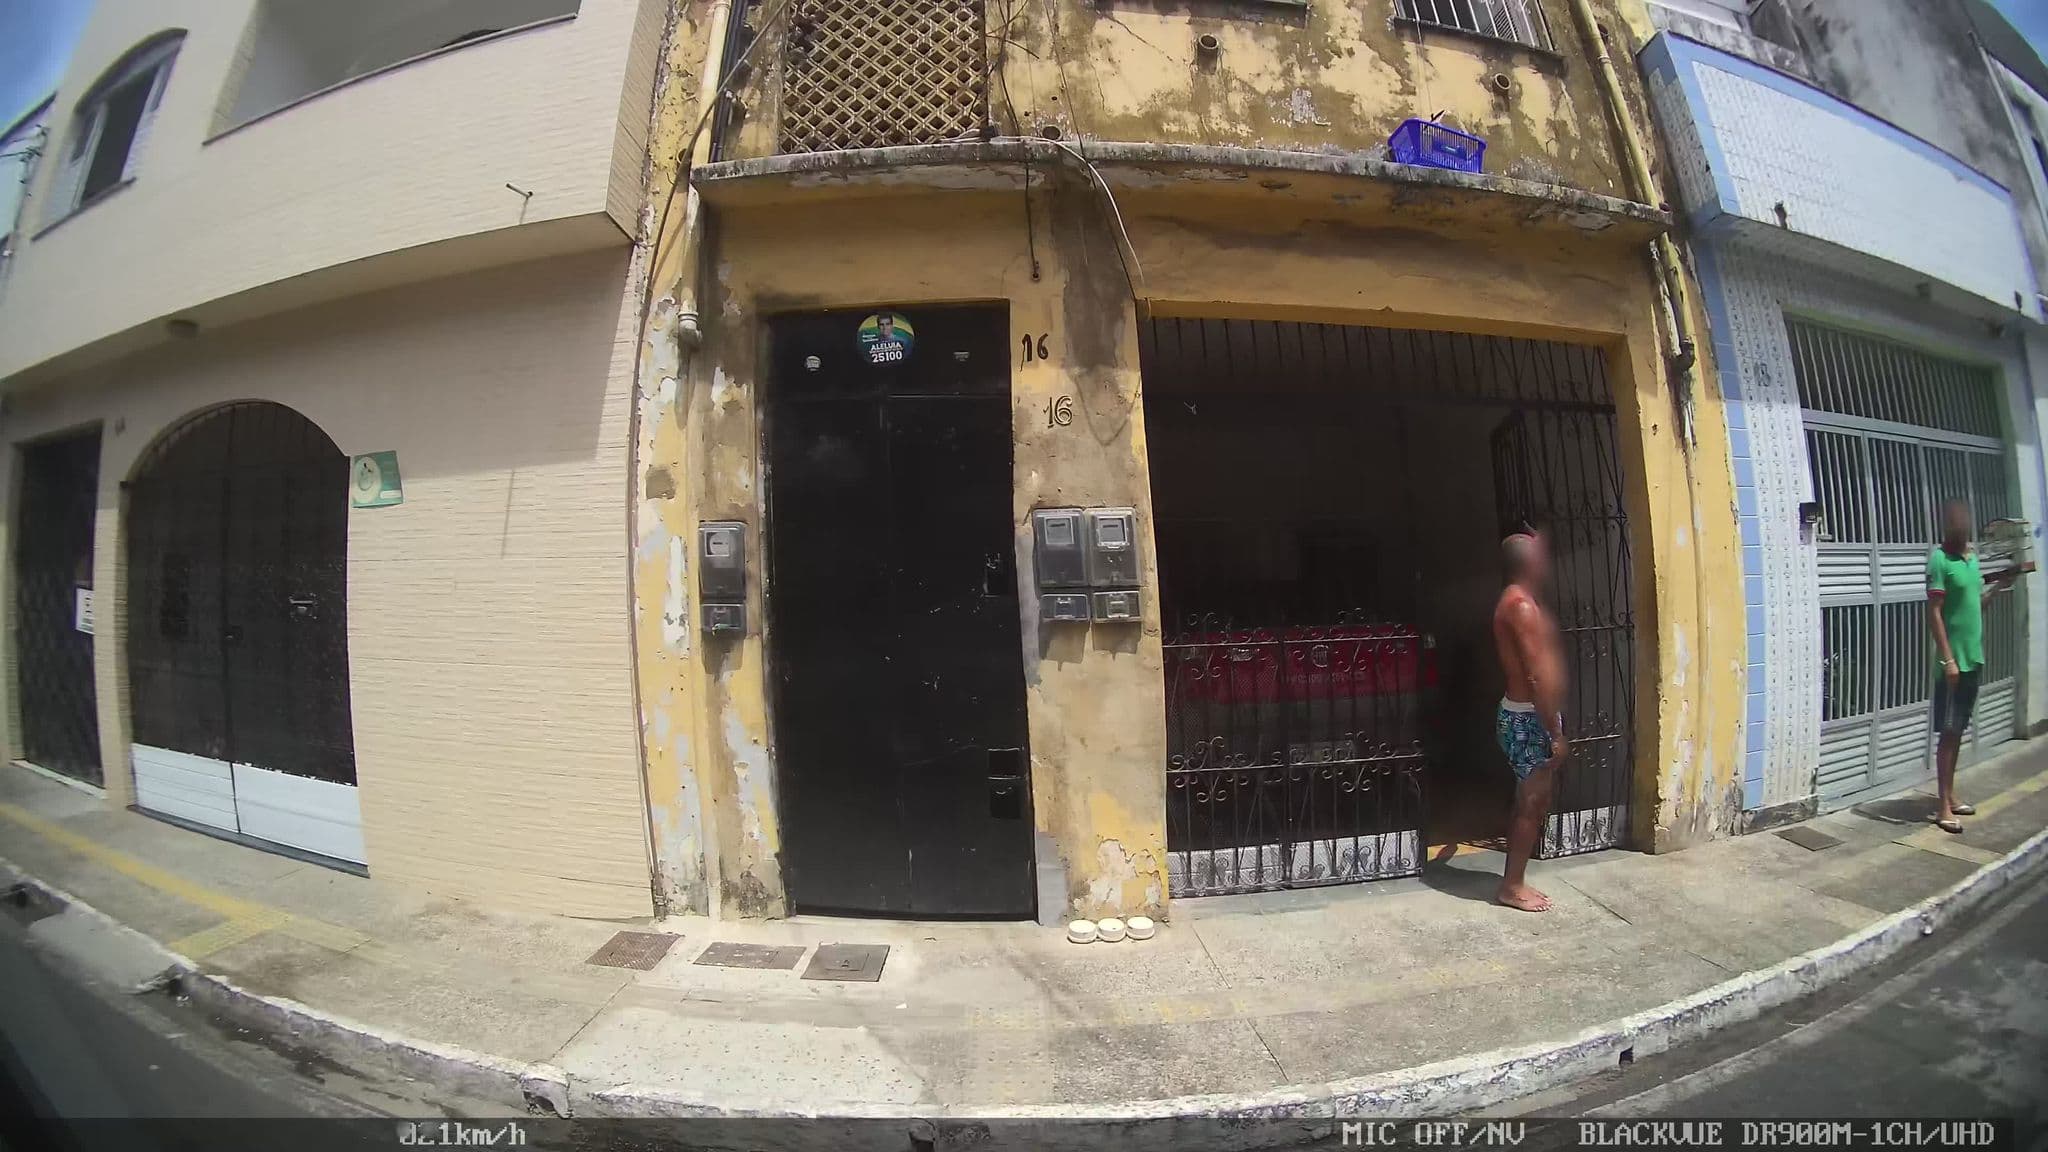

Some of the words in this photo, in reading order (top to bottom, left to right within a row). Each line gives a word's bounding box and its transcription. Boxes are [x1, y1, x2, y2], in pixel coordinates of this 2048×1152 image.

[871, 350, 903, 363] 25100
[1021, 333, 1049, 364] 16
[1042, 395, 1073, 429] 16
